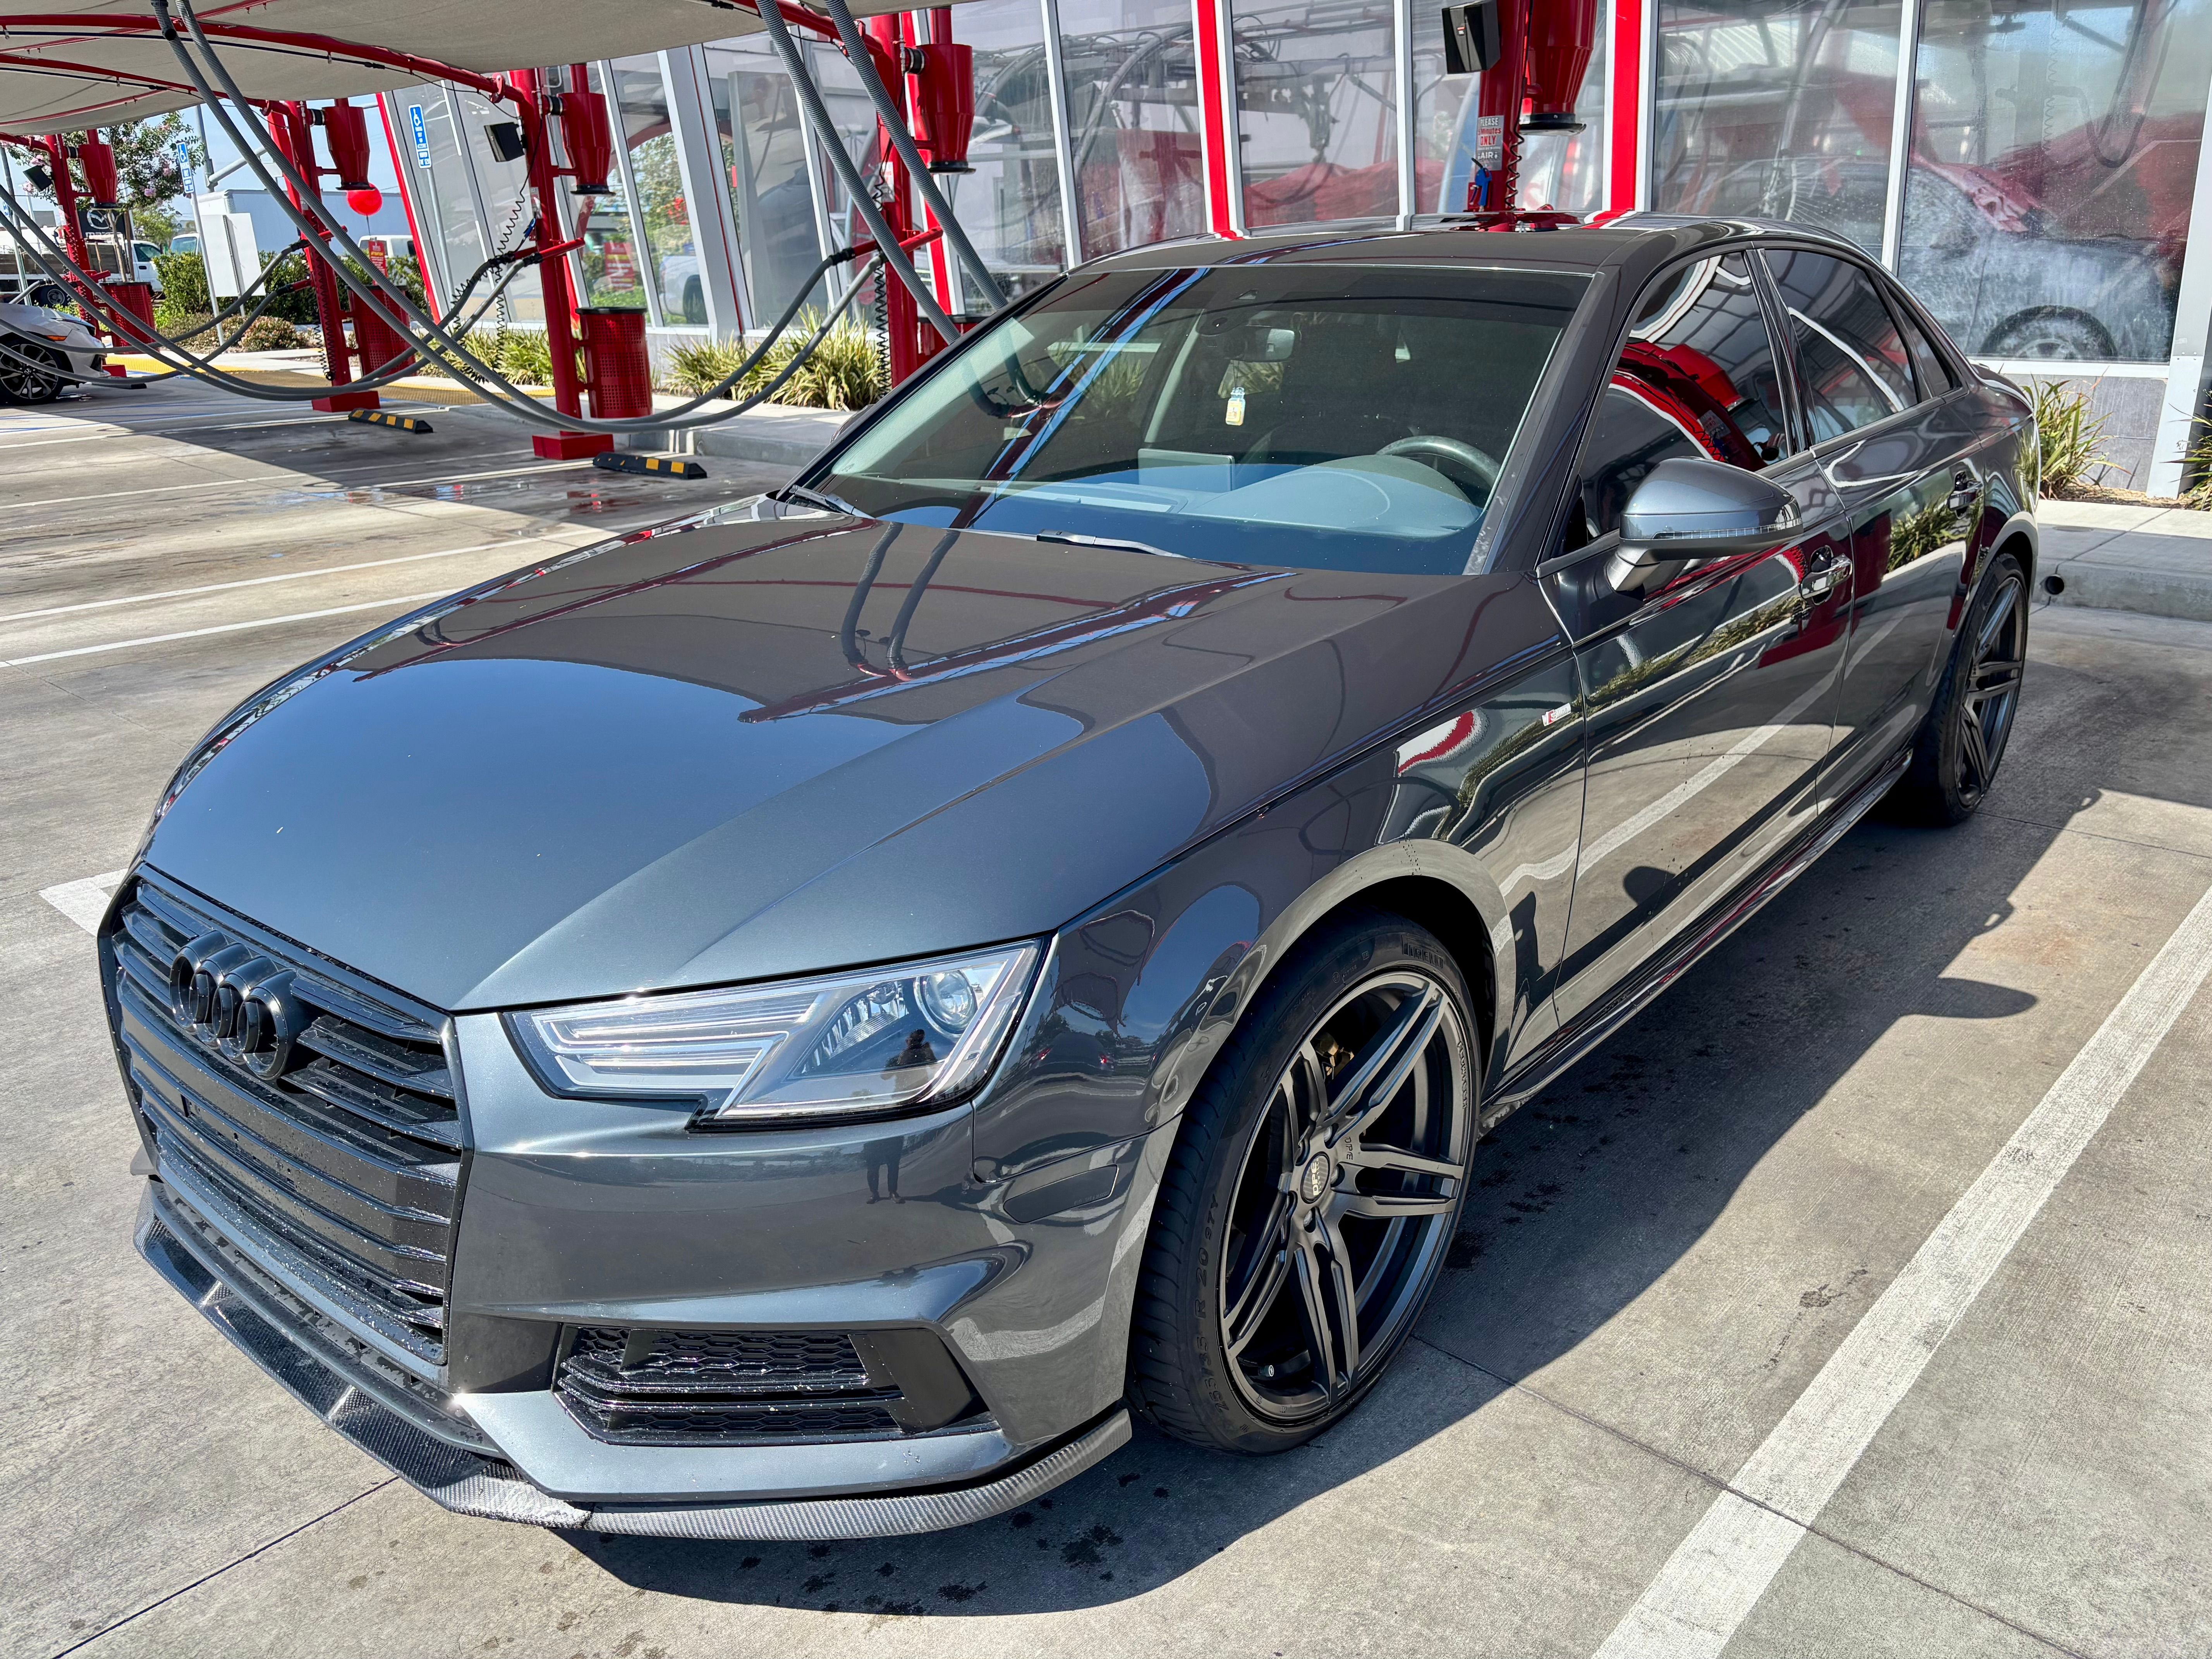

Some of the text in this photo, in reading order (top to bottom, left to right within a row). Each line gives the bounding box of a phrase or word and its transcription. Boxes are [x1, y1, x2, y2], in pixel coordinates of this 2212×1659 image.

[1480, 117, 1499, 127] PLEASE
[1480, 135, 1496, 146] ONLY
[1401, 933, 1443, 969] PIRELLI
[1345, 1137, 1353, 1160] DPE
[1311, 1162, 1319, 1196] DPE
[1205, 1194, 1218, 1240] 97Y
[1196, 1247, 1209, 1287] 20
[1195, 1299, 1206, 1319] R
